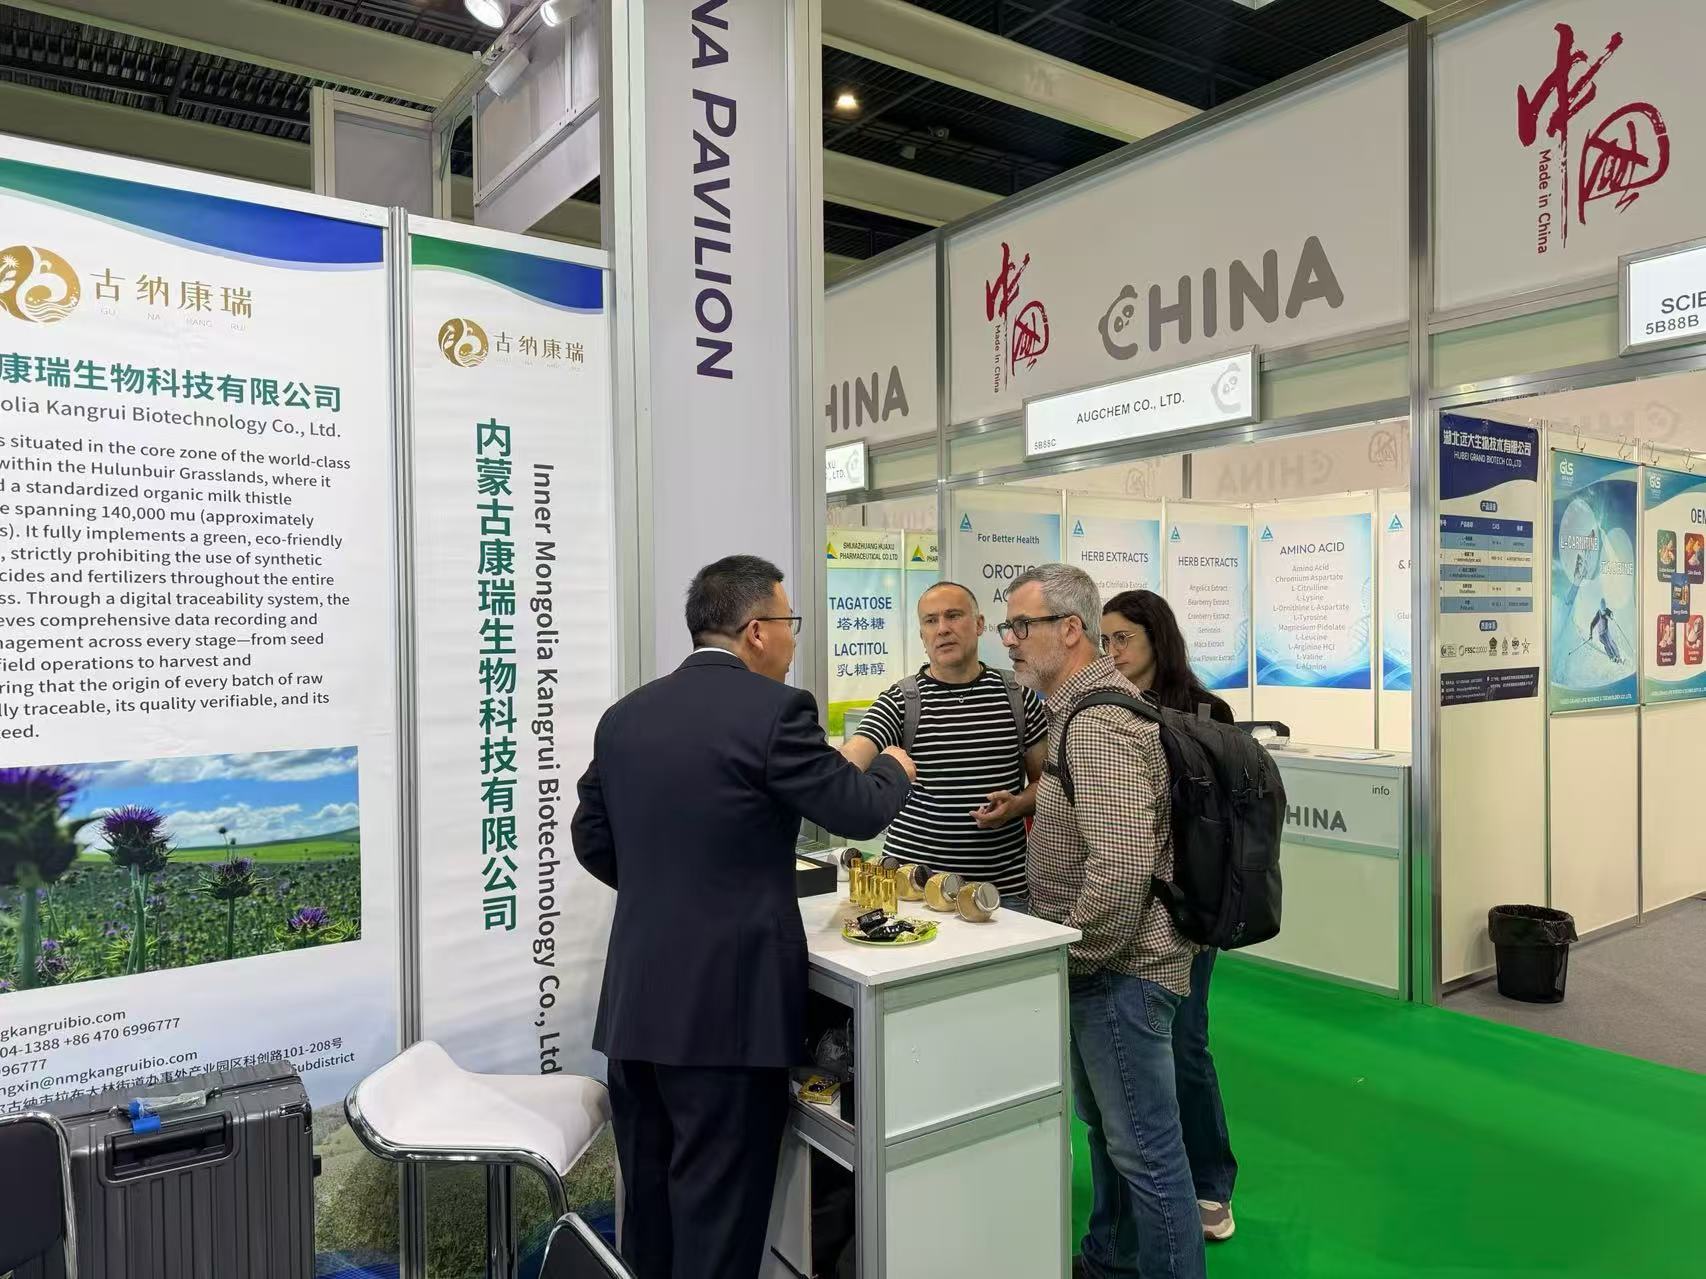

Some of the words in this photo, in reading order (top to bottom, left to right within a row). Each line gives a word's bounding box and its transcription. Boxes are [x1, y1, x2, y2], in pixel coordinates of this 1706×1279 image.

[1538, 149, 1551, 190] Made
[1539, 194, 1551, 208] in
[692, 88, 737, 379] PAVILION
[1537, 211, 1551, 254] China
[90, 268, 252, 319] 古纳康瑞
[1098, 235, 1344, 360] CHINA
[1646, 314, 1699, 334] 5B88B
[494, 332, 584, 364] 古纳康瑞
[993, 354, 1000, 364] in
[0, 353, 341, 412] 康瑞生物科技有限公司
[48, 400, 125, 422] Kangrui
[133, 407, 267, 434] Biotechnology
[272, 419, 304, 437] Co.,
[310, 422, 340, 437] Ltd.
[1076, 402, 1130, 424] AUGCHEM
[1134, 398, 1156, 412] CO.,
[1160, 392, 1184, 408] LTD.
[11, 435, 82, 451] situated
[108, 441, 136, 454] the
[140, 446, 175, 457] core
[180, 449, 216, 460] zone
[240, 450, 264, 463] the
[269, 454, 350, 469] world-class
[1454, 450, 1469, 460] HUBEI
[1470, 452, 1485, 462] GRAND
[1487, 456, 1505, 465] BIOTECH
[58, 460, 86, 473] the
[92, 462, 175, 478] Hulunbuir
[180, 468, 268, 486] Grasslands,
[272, 473, 317, 486] where
[26, 482, 138, 498] standardized
[144, 488, 203, 503] organic
[208, 490, 240, 502] milk
[246, 492, 291, 505] thistle
[533, 464, 554, 534] Inner
[16, 504, 96, 521] spanning
[102, 506, 165, 521] 140,000
[201, 509, 314, 529] (approximately
[43, 525, 81, 542] fully
[87, 526, 185, 543] implements
[204, 534, 251, 546] green,
[256, 533, 342, 549] eco-friendly
[978, 534, 990, 542] For
[992, 534, 1014, 543] Better
[1016, 536, 1039, 544] Health
[1280, 544, 1316, 555] AMINO
[1318, 542, 1344, 552] ACID
[11, 547, 72, 564] strictly
[78, 548, 170, 566] prohibiting
[175, 550, 200, 563] the
[206, 554, 231, 564] use
[255, 553, 322, 568] synthetic
[1082, 551, 1104, 561] HERB
[1106, 552, 1149, 562] EXTRACTS
[1178, 557, 1198, 566] HERB
[1201, 557, 1238, 567] EXTRACTS
[50, 570, 82, 582] and
[88, 570, 166, 583] fertilizers
[170, 571, 260, 587] throughout
[264, 573, 288, 585] the
[292, 574, 334, 585] entire
[26, 592, 100, 608] Through
[120, 592, 171, 608] digital
[176, 592, 263, 608] traceability
[268, 594, 323, 608] system,
[327, 594, 350, 605] the
[530, 541, 560, 660] Mongolia
[830, 596, 892, 610] TAGATOSE
[40, 613, 170, 629] comprehensive
[175, 613, 209, 625] data
[215, 613, 286, 628] recording
[291, 613, 317, 624] and
[837, 617, 885, 630] 塔格糖
[89, 638, 142, 648] across
[147, 638, 190, 649] every
[196, 633, 286, 649] stage—from
[291, 633, 323, 645] seed
[834, 642, 888, 656] LACTITOL
[41, 657, 134, 674] operations
[160, 656, 218, 667] harvest
[223, 654, 250, 666] and
[475, 418, 517, 931] 内蒙古康瑞生物科技有限公司
[837, 663, 886, 677] 乳糖醇
[39, 680, 74, 692] that
[80, 678, 107, 691] the
[112, 677, 159, 693] origin
[185, 678, 227, 690] every
[232, 674, 273, 686] batch
[297, 675, 322, 684] raw
[24, 700, 110, 715] traceable,
[140, 697, 196, 714] quality
[200, 694, 277, 708] verifiable,
[282, 692, 308, 705] and
[531, 668, 560, 770] Kangrui
[1372, 786, 1390, 795] info
[533, 778, 560, 967] Biotechnology
[535, 974, 560, 1027] Co.,
[64, 1033, 90, 1046] +86
[93, 1028, 119, 1042] 470
[122, 1018, 181, 1037] 6996777
